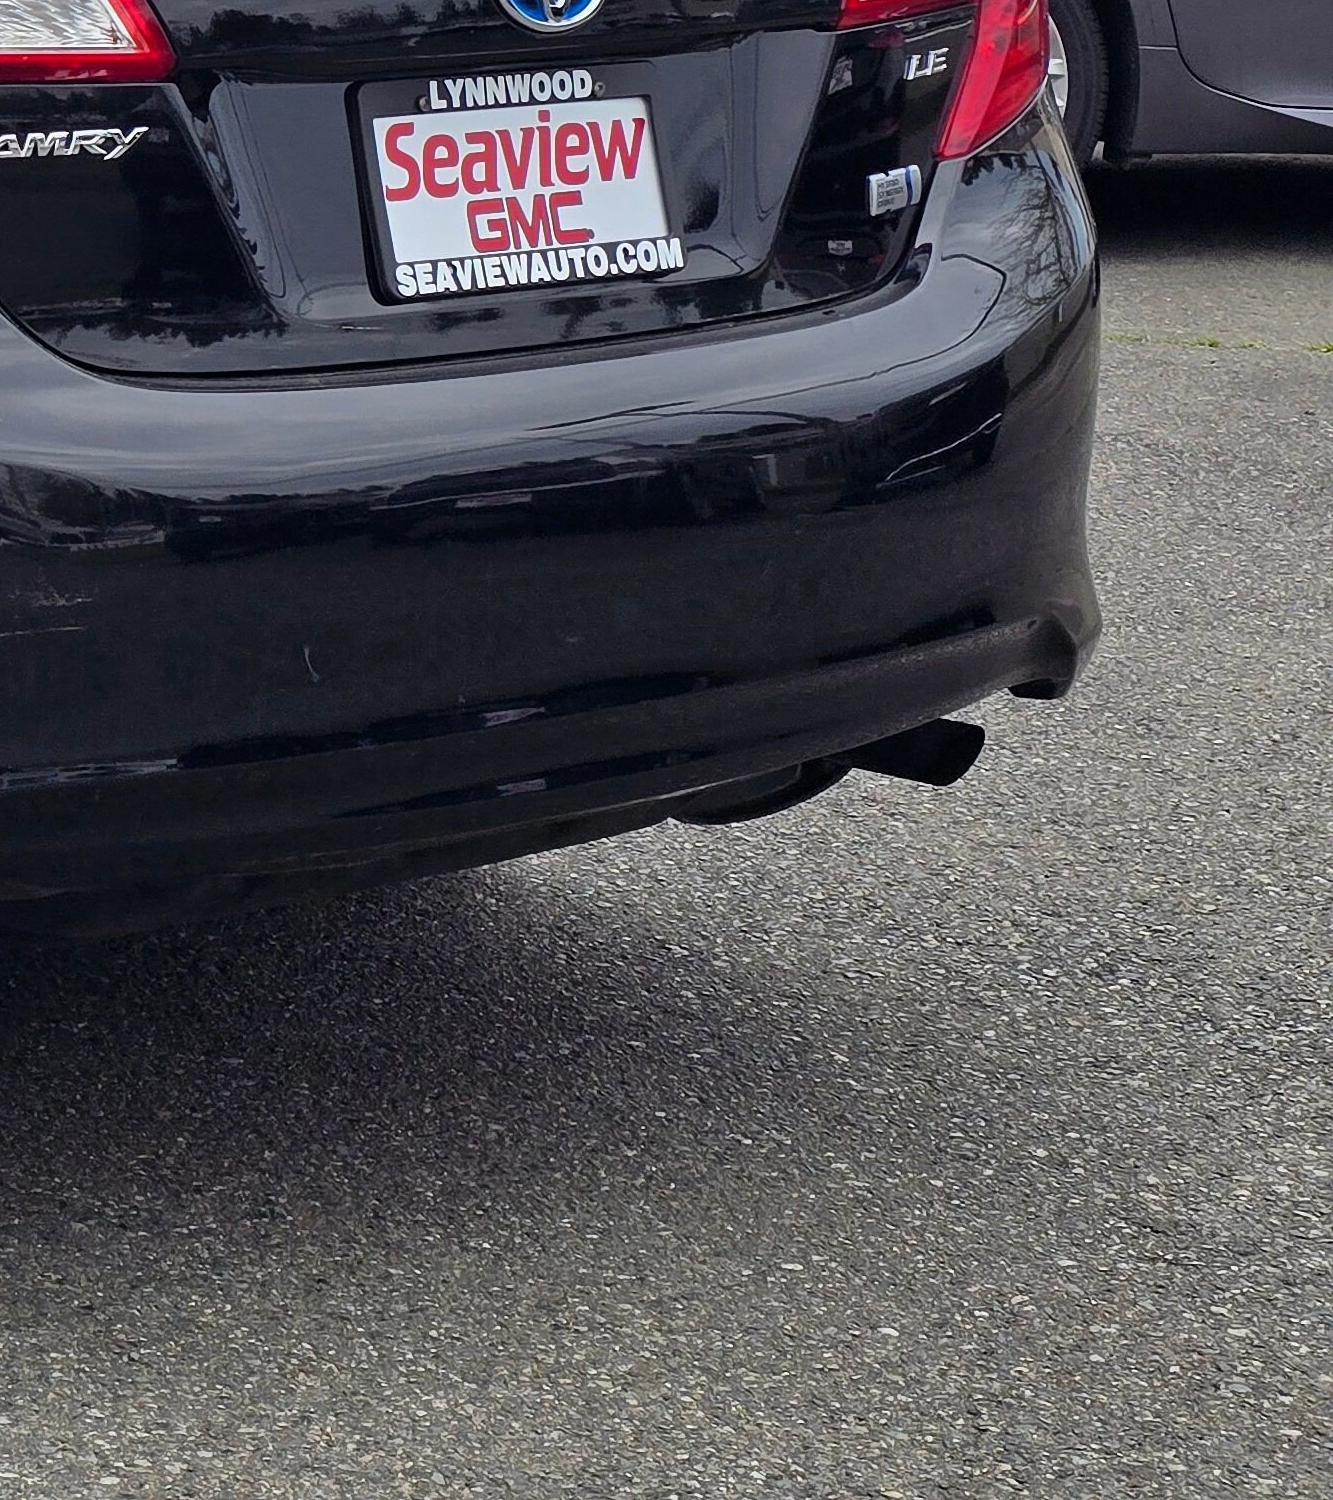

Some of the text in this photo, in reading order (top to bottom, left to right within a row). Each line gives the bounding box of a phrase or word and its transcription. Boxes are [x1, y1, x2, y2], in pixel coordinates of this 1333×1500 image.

[429, 69, 593, 110] LYNNWOOD
[903, 47, 949, 80] LE
[384, 109, 646, 202] Seaview
[466, 190, 595, 253] GMC
[395, 237, 684, 297] SEAVIEWAUTO.COM
